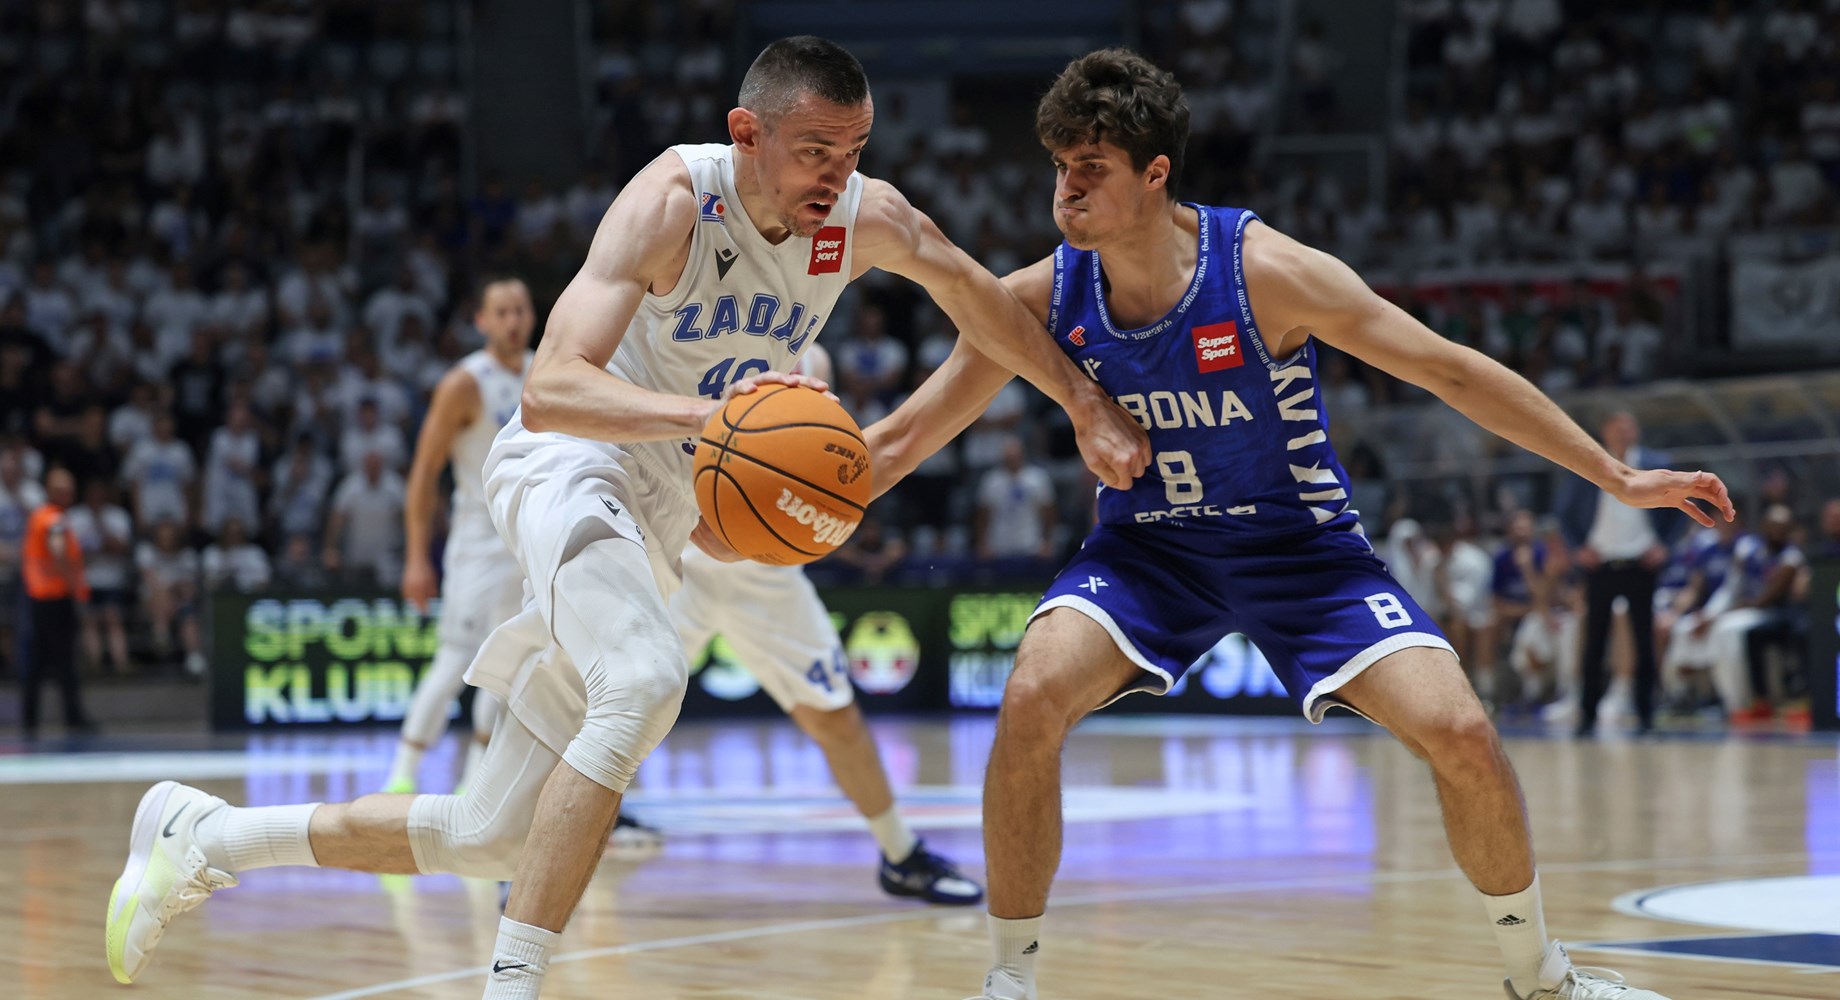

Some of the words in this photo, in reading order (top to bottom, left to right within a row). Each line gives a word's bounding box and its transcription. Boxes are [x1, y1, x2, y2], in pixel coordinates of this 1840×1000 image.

[1197, 334, 1236, 349] Super
[1201, 345, 1237, 361] Sport
[1112, 390, 1254, 430] BONA
[1156, 450, 1204, 505] 8
[1364, 592, 1413, 629] 8
[244, 661, 461, 724] KLUB
